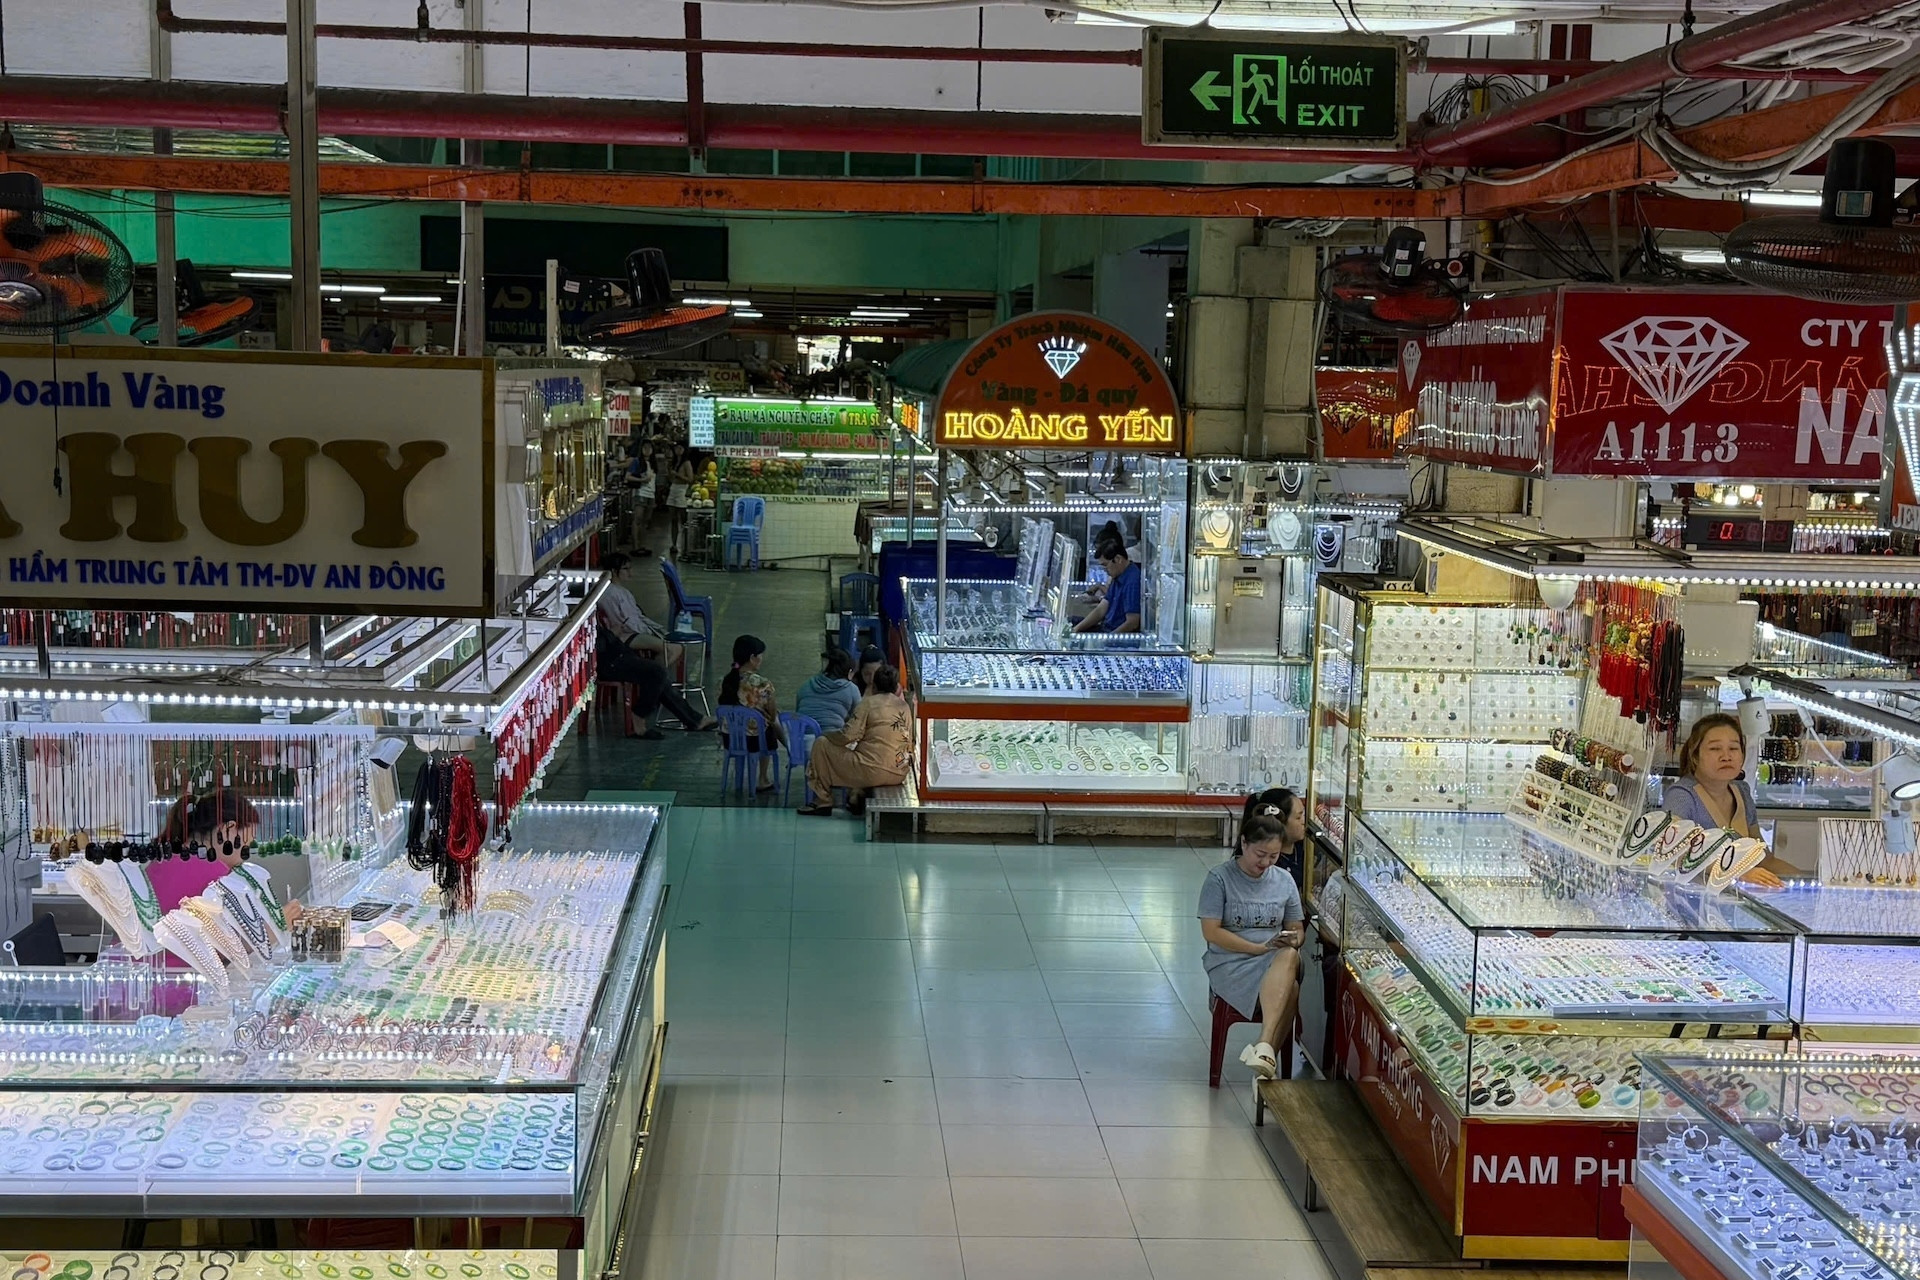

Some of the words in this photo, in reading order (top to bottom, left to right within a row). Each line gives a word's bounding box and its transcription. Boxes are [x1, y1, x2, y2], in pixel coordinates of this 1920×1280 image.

[1289, 56, 1316, 85] LỐI
[1319, 61, 1375, 87] THOÁT
[1297, 103, 1366, 128] EXIT
[996, 334, 1014, 349] Ty
[1800, 318, 1869, 348] CTY
[122, 372, 226, 419] Vàng
[980, 379, 1039, 406] Vàng
[730, 409, 750, 423] RAU
[768, 407, 808, 425] NGUYÊN
[943, 406, 1090, 441] HOÀNG
[1097, 405, 1174, 442] YẾN
[1794, 386, 1888, 466] NA
[1593, 421, 1740, 465] A111.3
[57, 431, 447, 548] HUY
[10, 550, 68, 584] HẦM
[75, 558, 166, 587] TRUNG
[173, 556, 229, 588] TÂM
[237, 562, 318, 589] TM-DV
[324, 564, 362, 590] AN
[369, 560, 446, 591] ĐÔNG
[1360, 1010, 1381, 1063] NAM
[1377, 1075, 1402, 1120] Jewelry
[1472, 1154, 1559, 1185] NAM
